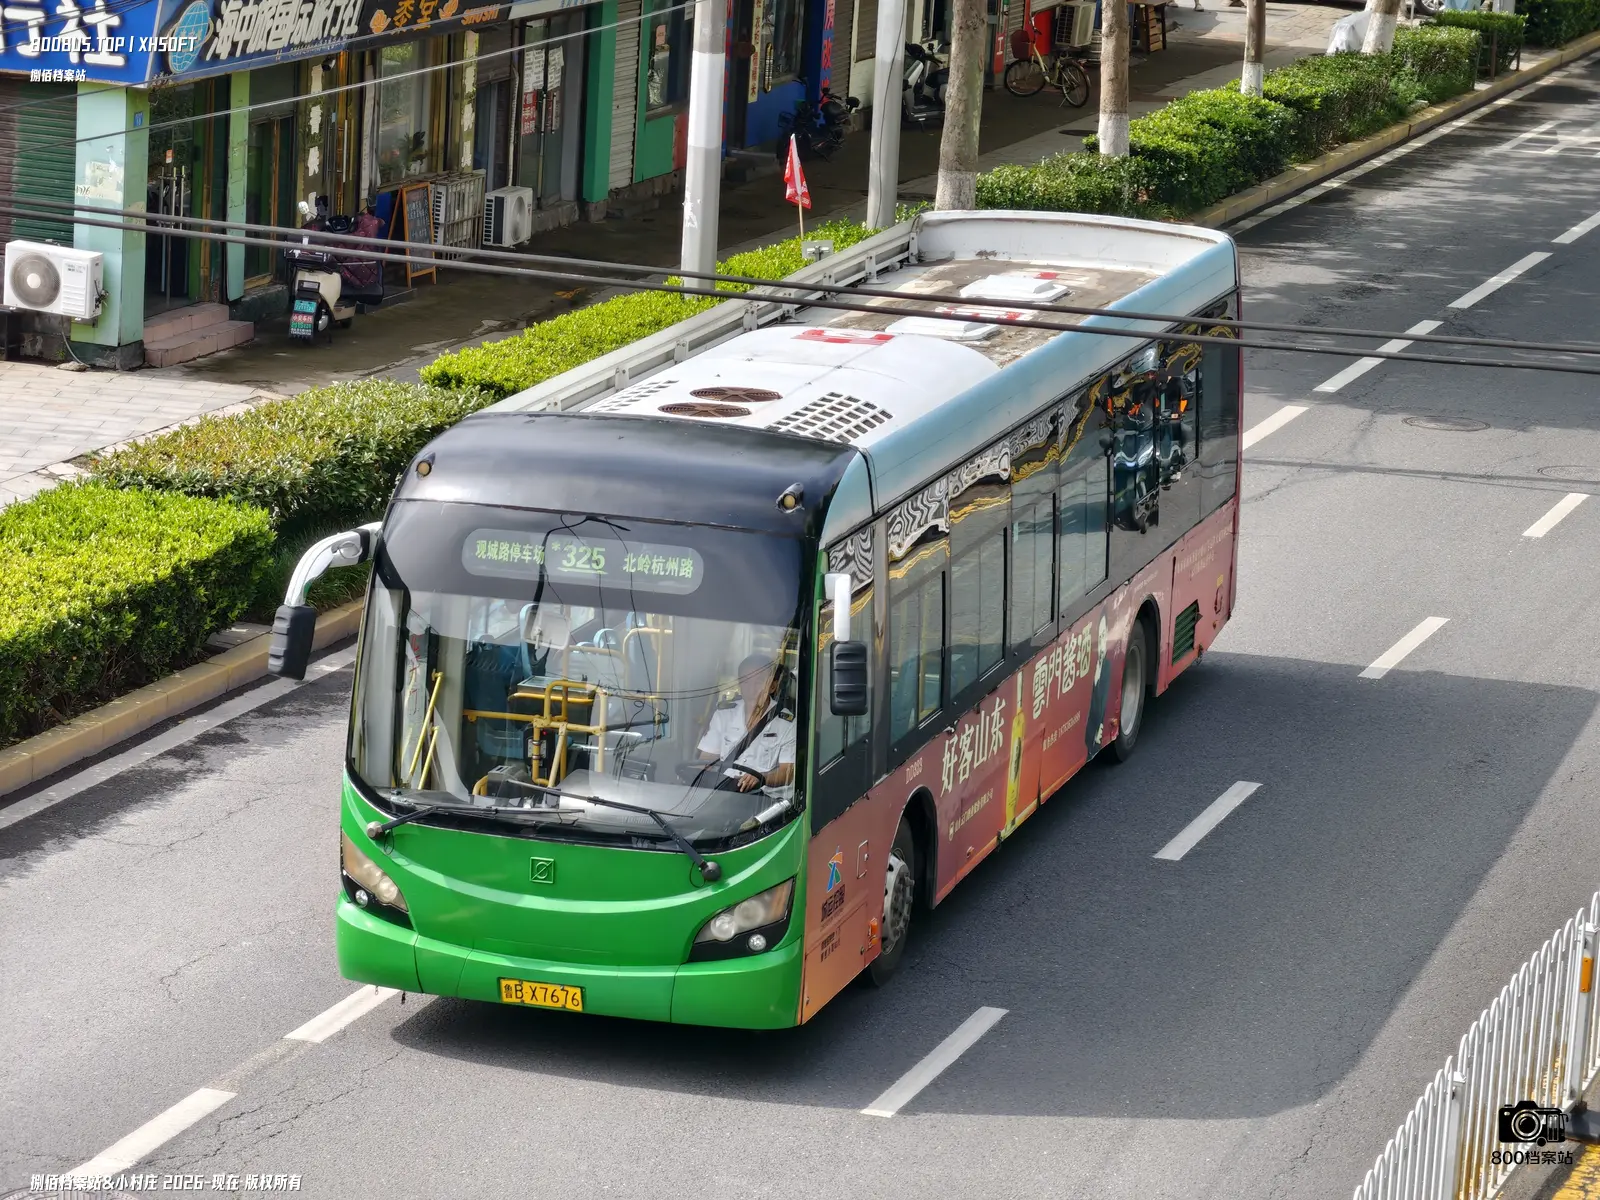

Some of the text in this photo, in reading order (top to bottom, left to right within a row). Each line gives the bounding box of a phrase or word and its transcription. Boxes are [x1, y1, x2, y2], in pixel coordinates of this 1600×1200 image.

[561, 547, 606, 569] 325
[622, 552, 695, 579] 北岭杭州路
